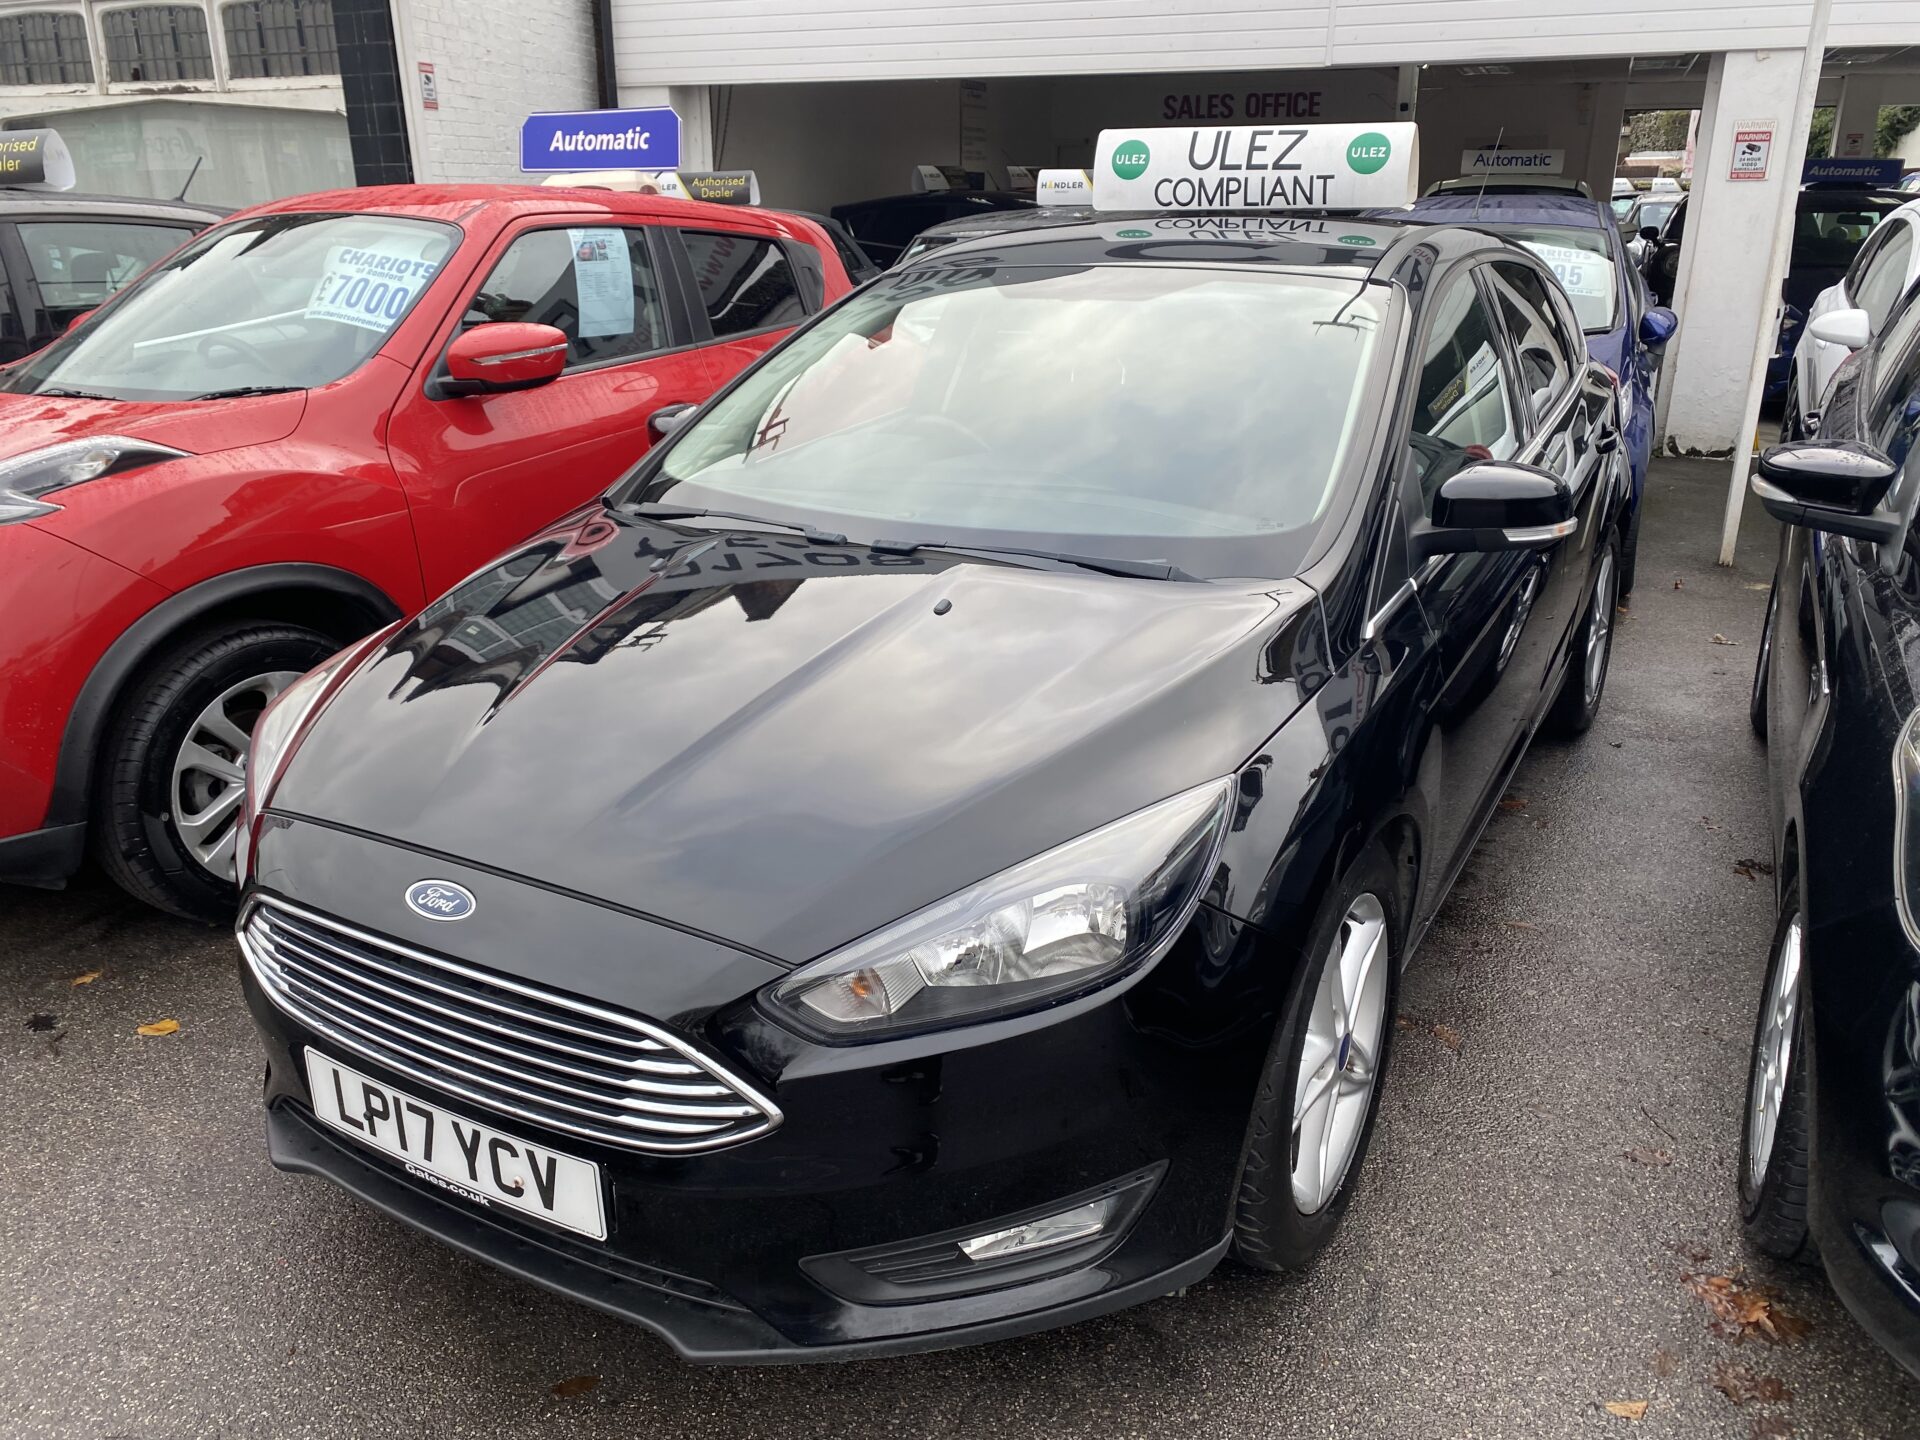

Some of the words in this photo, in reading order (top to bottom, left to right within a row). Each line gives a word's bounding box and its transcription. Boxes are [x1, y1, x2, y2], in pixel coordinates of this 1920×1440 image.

[1163, 94, 1235, 120] SALES
[1245, 91, 1322, 118] OFFICE
[0, 136, 39, 152] rised
[549, 126, 650, 152] Automatic
[1115, 153, 1147, 166] ULEZ
[1188, 129, 1308, 171] ULEZ
[1351, 146, 1387, 159] ULEZ
[0, 154, 21, 171] ler
[1473, 153, 1553, 167] Automatic
[1808, 165, 1881, 176] Automatic
[661, 183, 678, 191] LER
[692, 176, 745, 187] Authorised
[1154, 174, 1336, 208] COMPLIANT
[701, 188, 734, 199] Dealer
[1536, 248, 1592, 260] ARIOTS
[338, 248, 437, 280] CHARIOTS
[1553, 263, 1583, 286] 95
[309, 310, 390, 331] www.chariotsofromford
[418, 886, 461, 912] Ford
[332, 1068, 435, 1163] LP17
[451, 1119, 557, 1212] YCV
[404, 1162, 491, 1208] Gates.co.uk
